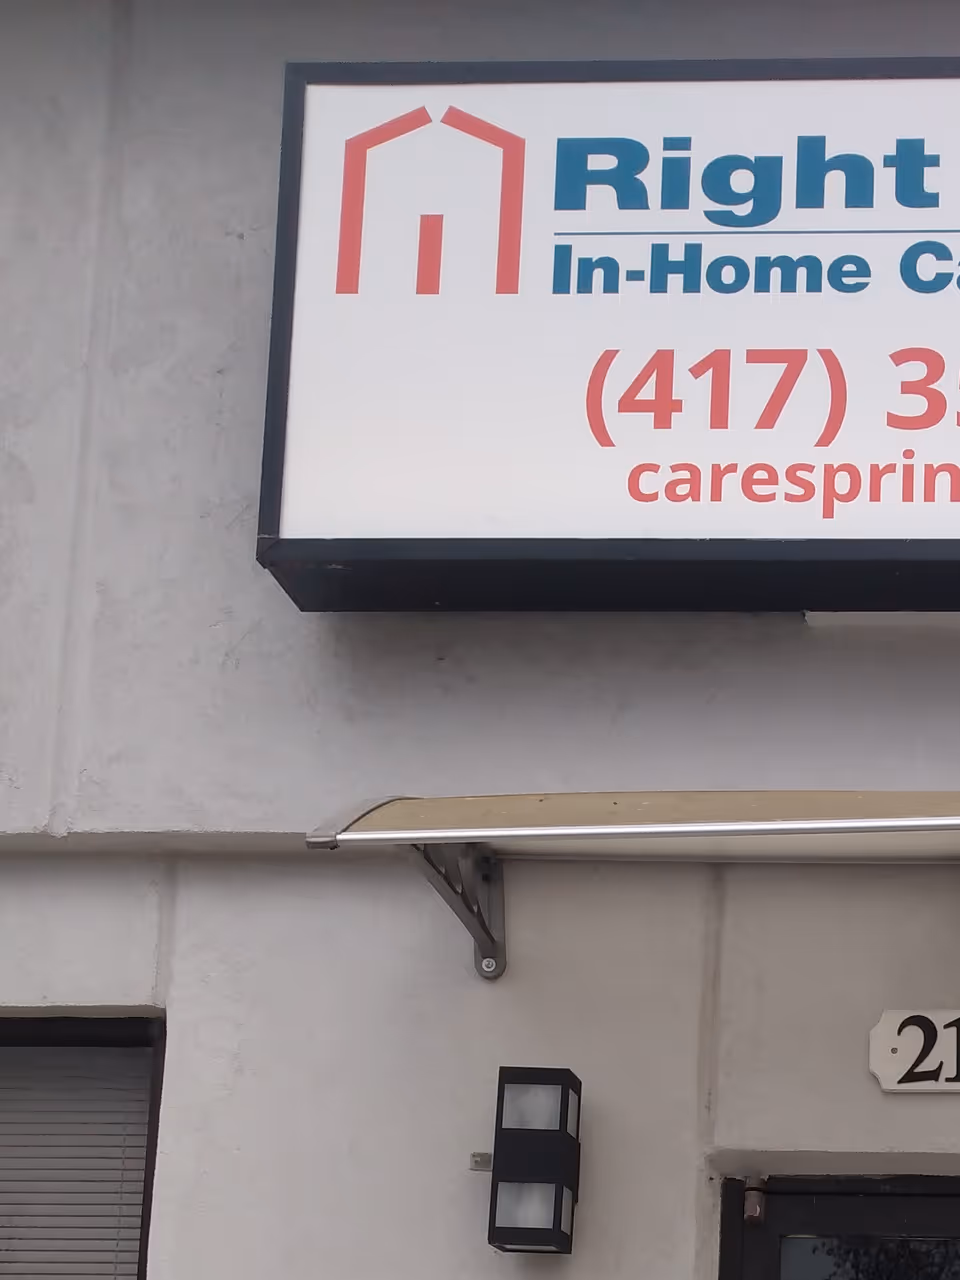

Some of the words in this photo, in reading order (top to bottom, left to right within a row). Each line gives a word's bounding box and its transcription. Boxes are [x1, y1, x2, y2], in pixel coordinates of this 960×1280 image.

[554, 135, 940, 226] Right
[551, 243, 872, 294] In-Home
[585, 347, 849, 448] (417)
